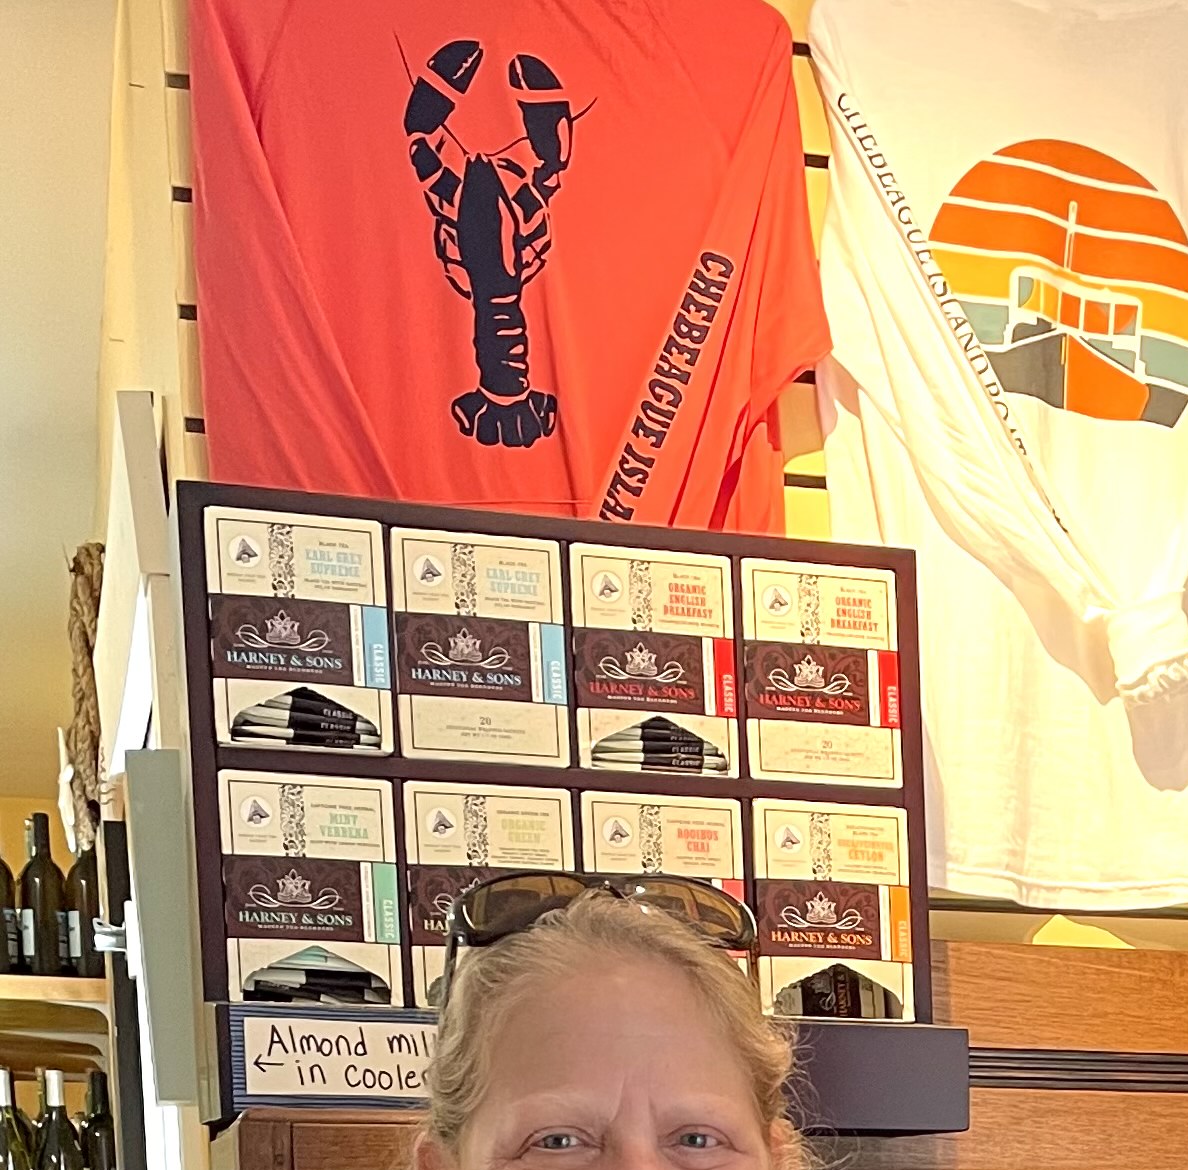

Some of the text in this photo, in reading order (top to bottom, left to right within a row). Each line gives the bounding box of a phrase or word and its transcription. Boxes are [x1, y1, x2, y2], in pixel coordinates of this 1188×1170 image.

[631, 251, 735, 449] CHEBEAGUE
[668, 582, 707, 595] ORGANIC
[669, 594, 706, 607] ENGLISH
[663, 605, 713, 619] BREAKFAST
[226, 650, 287, 665] HARNEY
[290, 655, 303, 667] &
[305, 656, 343, 669] SONS
[373, 643, 385, 683] CLASSIC
[411, 667, 469, 683] HARNEY
[471, 671, 485, 684] &
[485, 672, 522, 686] SONS
[550, 660, 562, 699] CLASSIC
[589, 682, 644, 696] HARNEY
[647, 686, 659, 697] &
[660, 686, 696, 700] SONS
[722, 674, 734, 713] CLASSIC
[758, 693, 812, 707] HARNEY
[815, 696, 826, 708] &
[828, 697, 862, 711] SONS
[887, 685, 899, 724] CLASSIC
[479, 716, 492, 726] 20
[822, 740, 833, 749] 20
[239, 910, 353, 927] HARNEY & SONS
[383, 899, 395, 939] CLASSIC
[771, 930, 825, 944] HARNEY
[827, 932, 839, 944] &
[840, 932, 873, 946] SONS
[267, 1024, 436, 1058] Almond mil
[294, 1059, 327, 1087] in
